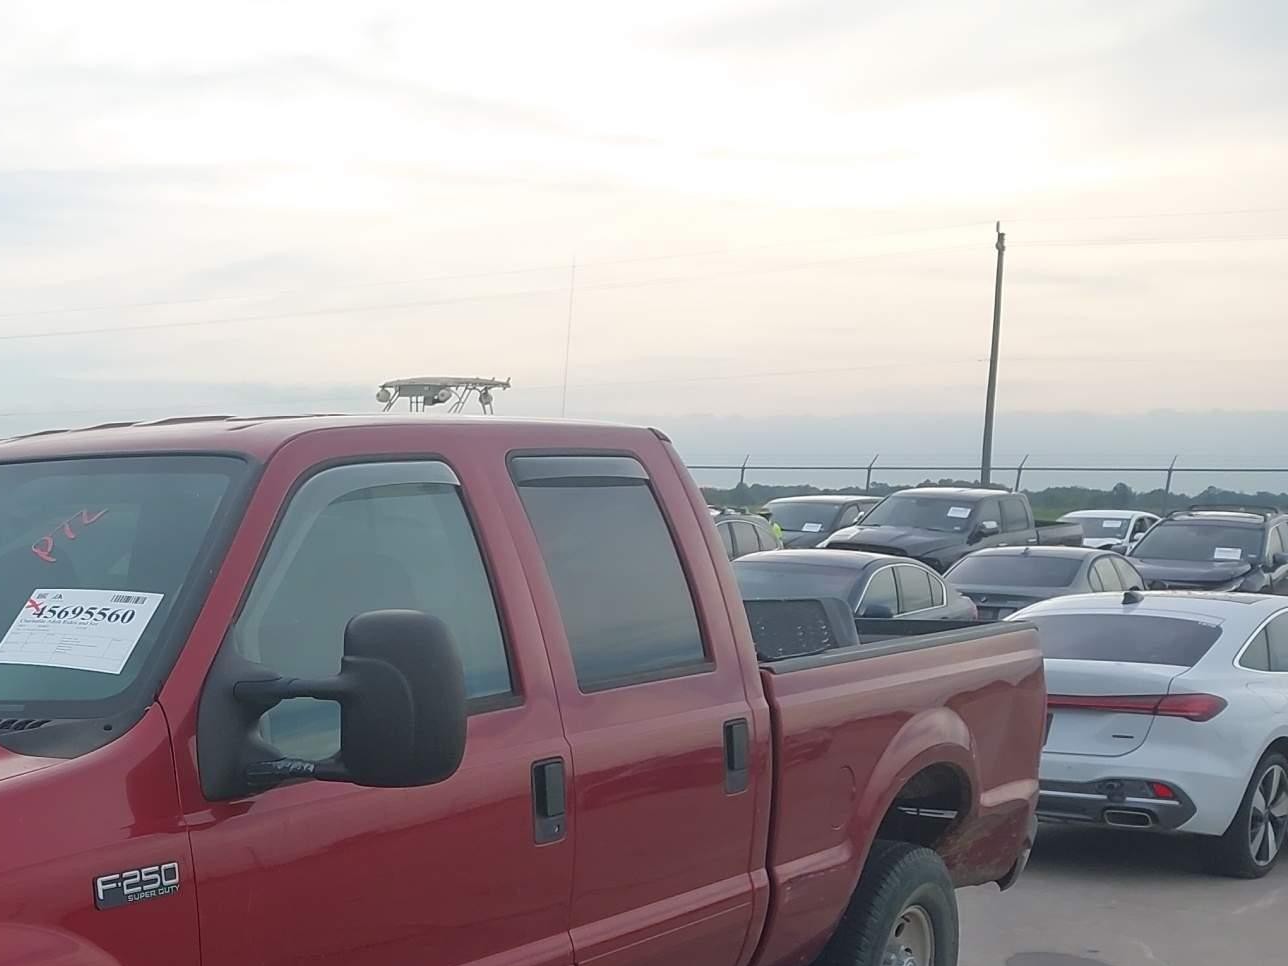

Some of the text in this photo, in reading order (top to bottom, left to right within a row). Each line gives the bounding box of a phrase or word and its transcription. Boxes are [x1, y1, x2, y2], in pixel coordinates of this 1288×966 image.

[32, 605, 136, 624] 45695560
[127, 885, 179, 902] SUPER DUTY
